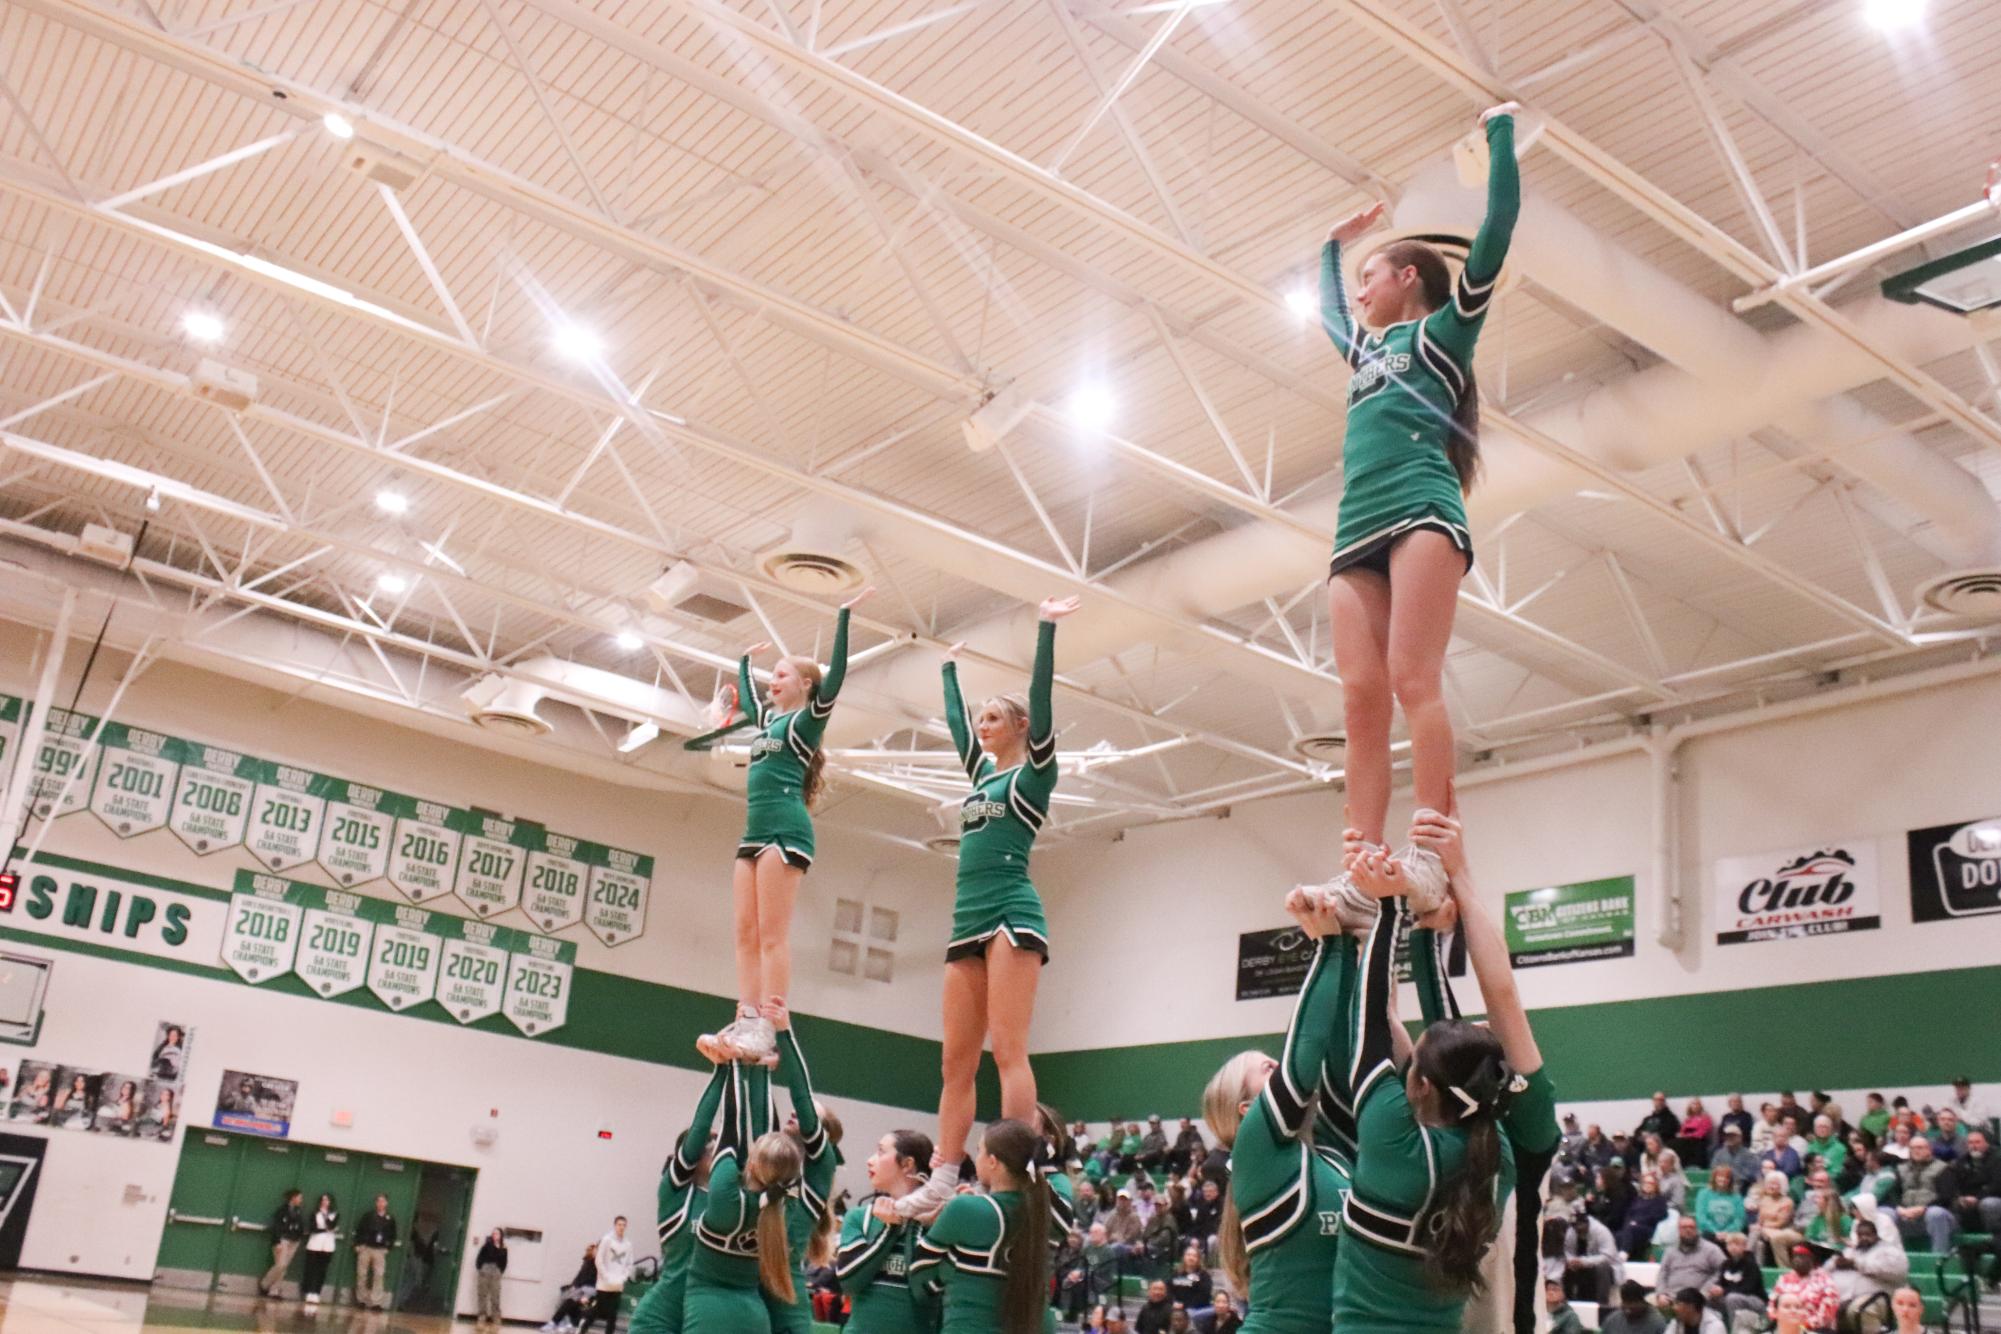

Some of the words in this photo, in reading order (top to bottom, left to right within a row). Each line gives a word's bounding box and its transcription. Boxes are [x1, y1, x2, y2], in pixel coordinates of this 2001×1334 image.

[33, 745, 88, 780] 99
[107, 763, 164, 799] 2001
[125, 797, 150, 811] STATE
[103, 804, 152, 823] CHAMPIONS
[202, 815, 225, 830] STATE
[260, 800, 312, 833] 2013
[182, 821, 228, 840] CHAMPIONS
[276, 832, 299, 846] STATE
[331, 816, 380, 849] 2015
[256, 839, 301, 857] CHAMPIONS
[348, 849, 369, 862] STATE
[401, 834, 448, 866] 2016
[328, 856, 372, 873] CHAMPIONS
[417, 866, 437, 878] STATE
[468, 850, 515, 881] 2017
[398, 872, 441, 890] CHAMPIONS
[531, 865, 578, 897] 2018
[1961, 859, 2001, 890] DO
[466, 888, 506, 905] CHAMPIONS
[484, 881, 504, 895] STATE
[593, 880, 640, 911] 2024
[1738, 872, 1855, 915] Club
[531, 903, 570, 919] CHAMPIONS
[548, 897, 568, 909] STATE
[593, 917, 632, 932] CHAMPIONS
[610, 910, 629, 922] STATE
[1736, 906, 1853, 928] CARWASH
[235, 910, 290, 943] 2018
[254, 943, 275, 957] STATE
[309, 924, 361, 958] 2019
[232, 950, 279, 968] CHAMPIONS
[325, 958, 348, 970] STATE
[381, 939, 430, 971] 2019
[1241, 955, 1275, 968] DERBY
[306, 964, 351, 982] CHAMPIONS
[396, 972, 418, 984] STATE
[447, 953, 499, 986] 2020
[377, 977, 420, 996] CHAMPIONS
[464, 985, 485, 997] STATE
[513, 968, 562, 999] 2023
[446, 992, 488, 1009] CHAMPIONS
[530, 999, 550, 1011] STATE
[513, 1005, 553, 1022] CHAMPIONS
